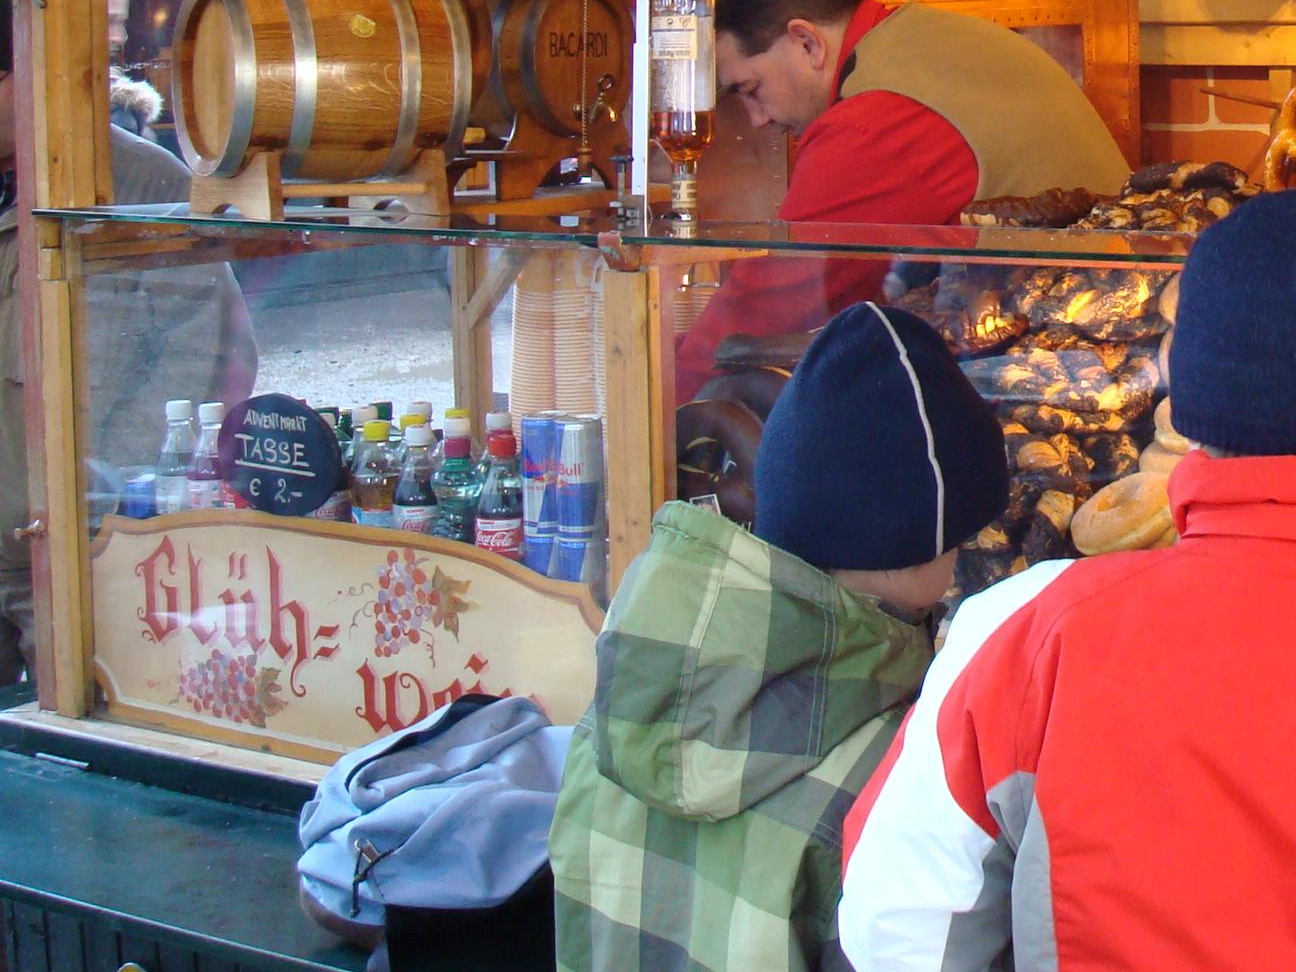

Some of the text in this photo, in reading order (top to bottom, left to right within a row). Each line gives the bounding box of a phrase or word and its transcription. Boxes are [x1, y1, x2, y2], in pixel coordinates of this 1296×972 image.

[549, 32, 608, 58] BACARDI
[234, 433, 310, 468] TASSE
[559, 463, 581, 476] Bull
[250, 478, 261, 496] €
